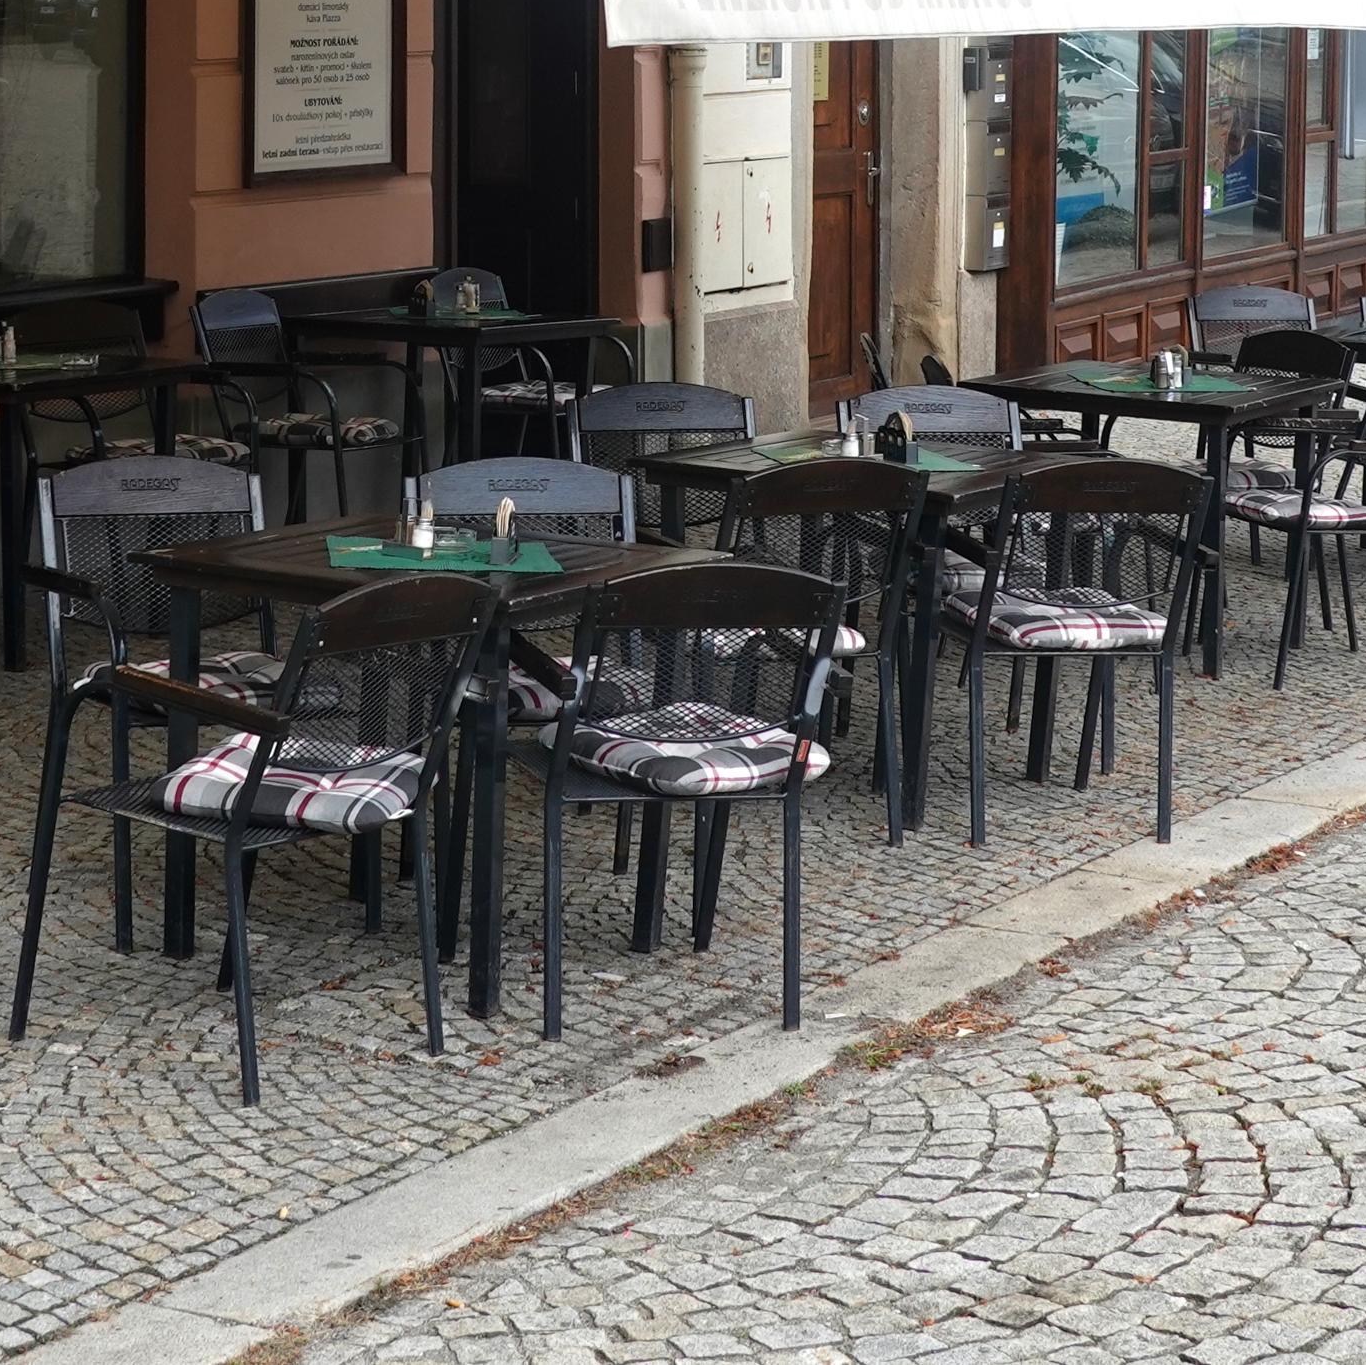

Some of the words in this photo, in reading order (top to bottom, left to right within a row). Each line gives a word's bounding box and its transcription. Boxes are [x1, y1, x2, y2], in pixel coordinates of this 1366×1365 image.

[290, 38, 321, 48] MOŽNOST
[904, 403, 953, 414] RADEGAST
[121, 478, 181, 492] RADEGAST
[488, 478, 550, 492] RADEGAST
